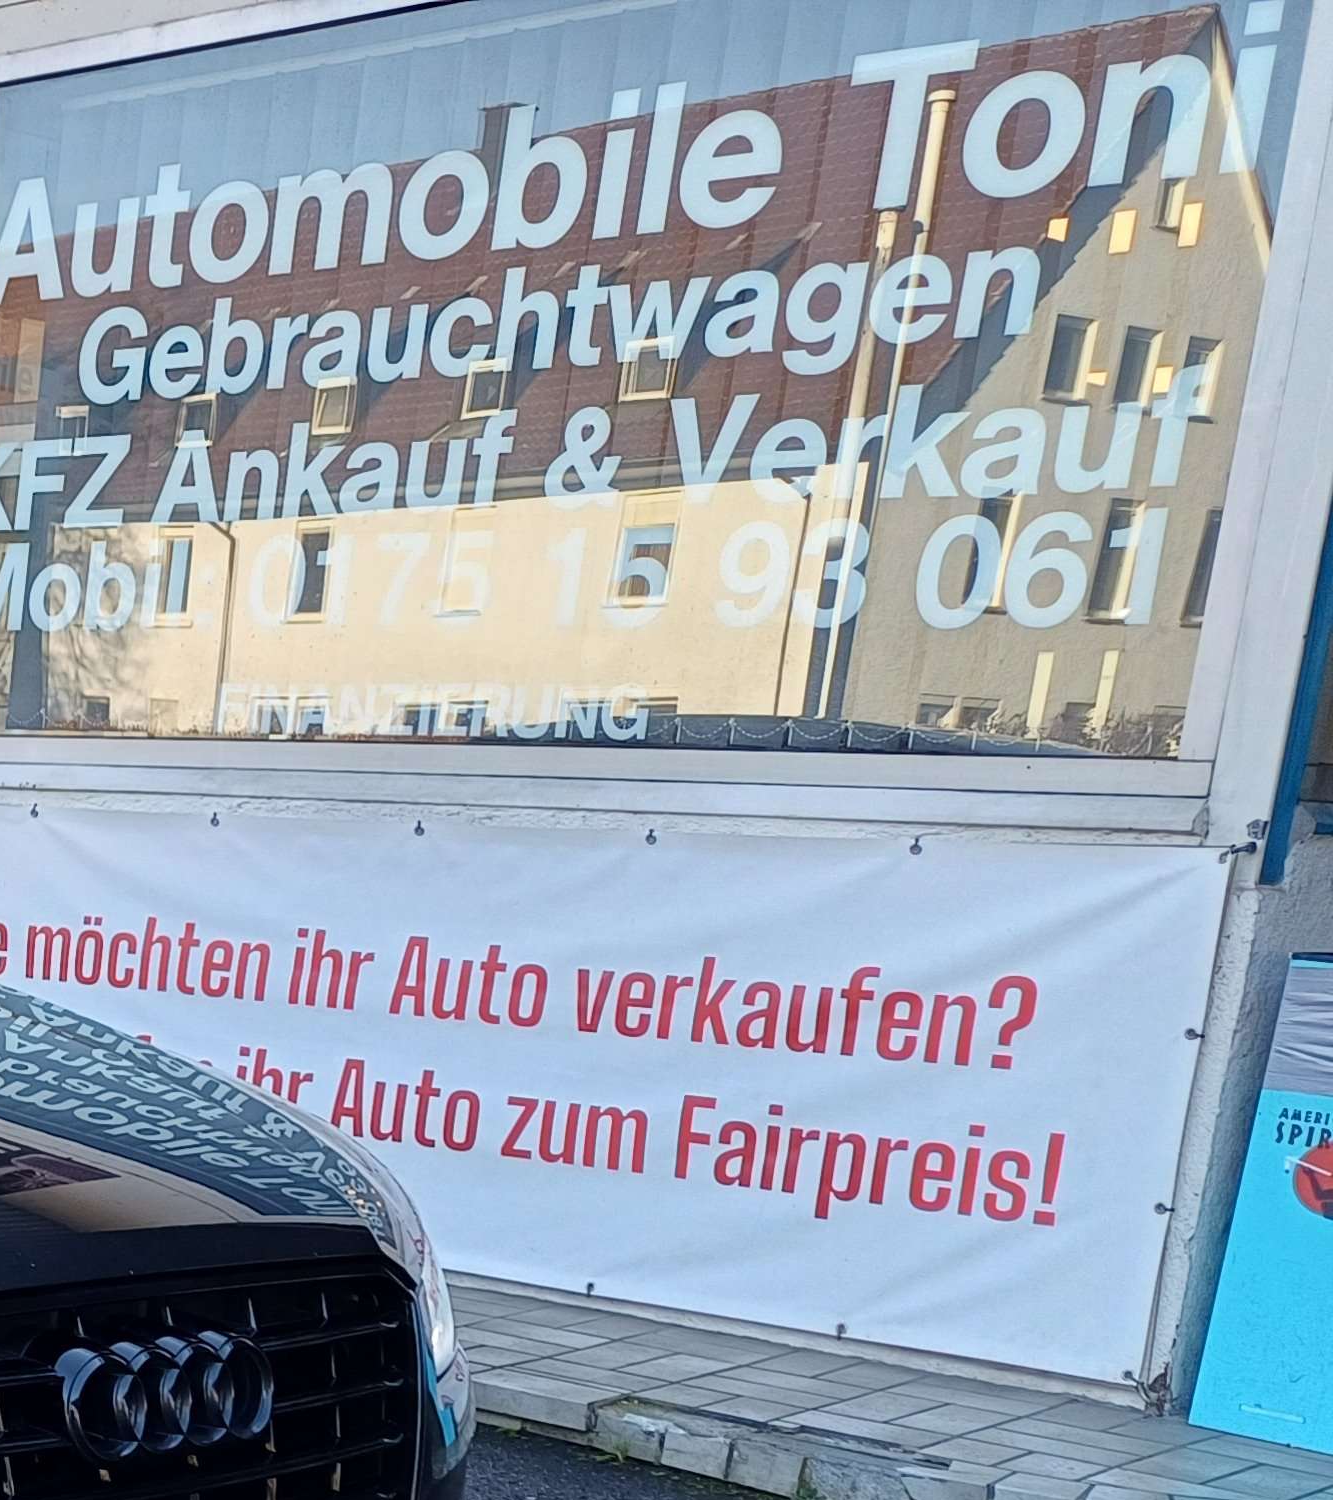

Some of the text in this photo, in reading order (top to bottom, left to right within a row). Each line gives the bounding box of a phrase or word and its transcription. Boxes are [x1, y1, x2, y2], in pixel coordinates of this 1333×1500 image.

[850, 0, 1285, 211] Toni
[78, 245, 1042, 406] Gebrauchtwagen
[149, 408, 519, 524] Ankauf
[543, 405, 622, 508] &
[669, 363, 1212, 508] Verkauf
[247, 528, 497, 632] 0175
[546, 521, 671, 630] 15
[712, 516, 870, 629] 93
[915, 507, 1170, 630] 061
[216, 682, 650, 742] FINANZIERUNG
[25, 915, 271, 1002] möchten
[287, 927, 376, 1011] ihr
[389, 935, 549, 1029] Auto
[576, 955, 1039, 1071] verkaufen?
[329, 1057, 481, 1152] Auto
[500, 1095, 649, 1175] zum
[674, 1094, 1067, 1228] Fairpreis!
[1278, 1107, 1333, 1127] AMERI
